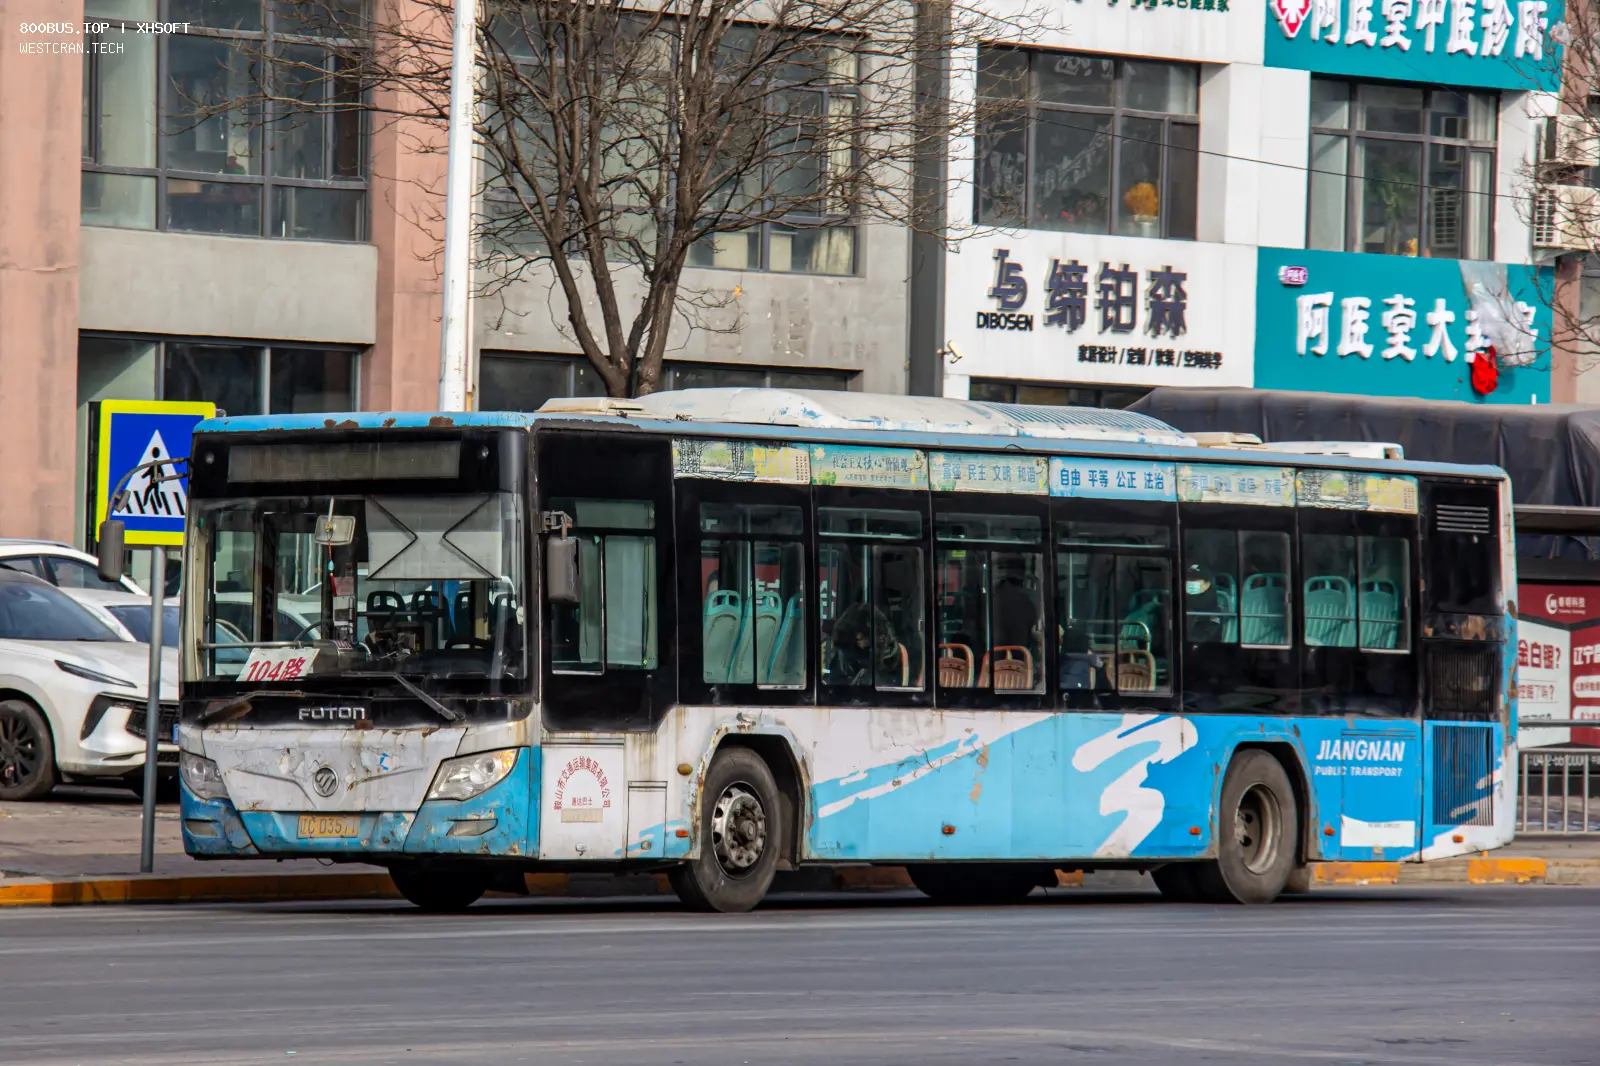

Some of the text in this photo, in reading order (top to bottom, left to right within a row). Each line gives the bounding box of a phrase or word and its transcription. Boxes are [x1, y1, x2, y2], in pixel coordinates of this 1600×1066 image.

[1310, 0, 1548, 60] 阿医堂中医诊所
[1043, 258, 1188, 339] 缔铂森
[976, 311, 1033, 331] DIBOSEN
[1295, 291, 1537, 364] 阿医堂大
[967, 463, 986, 481] 民主
[1060, 468, 1164, 490] 自由 平等 公正 法治
[246, 657, 306, 682] 104路
[298, 706, 365, 721] FOTON
[1316, 739, 1405, 761] JIANGNAN
[1314, 766, 1403, 777] PUBLIC TRANSPORT
